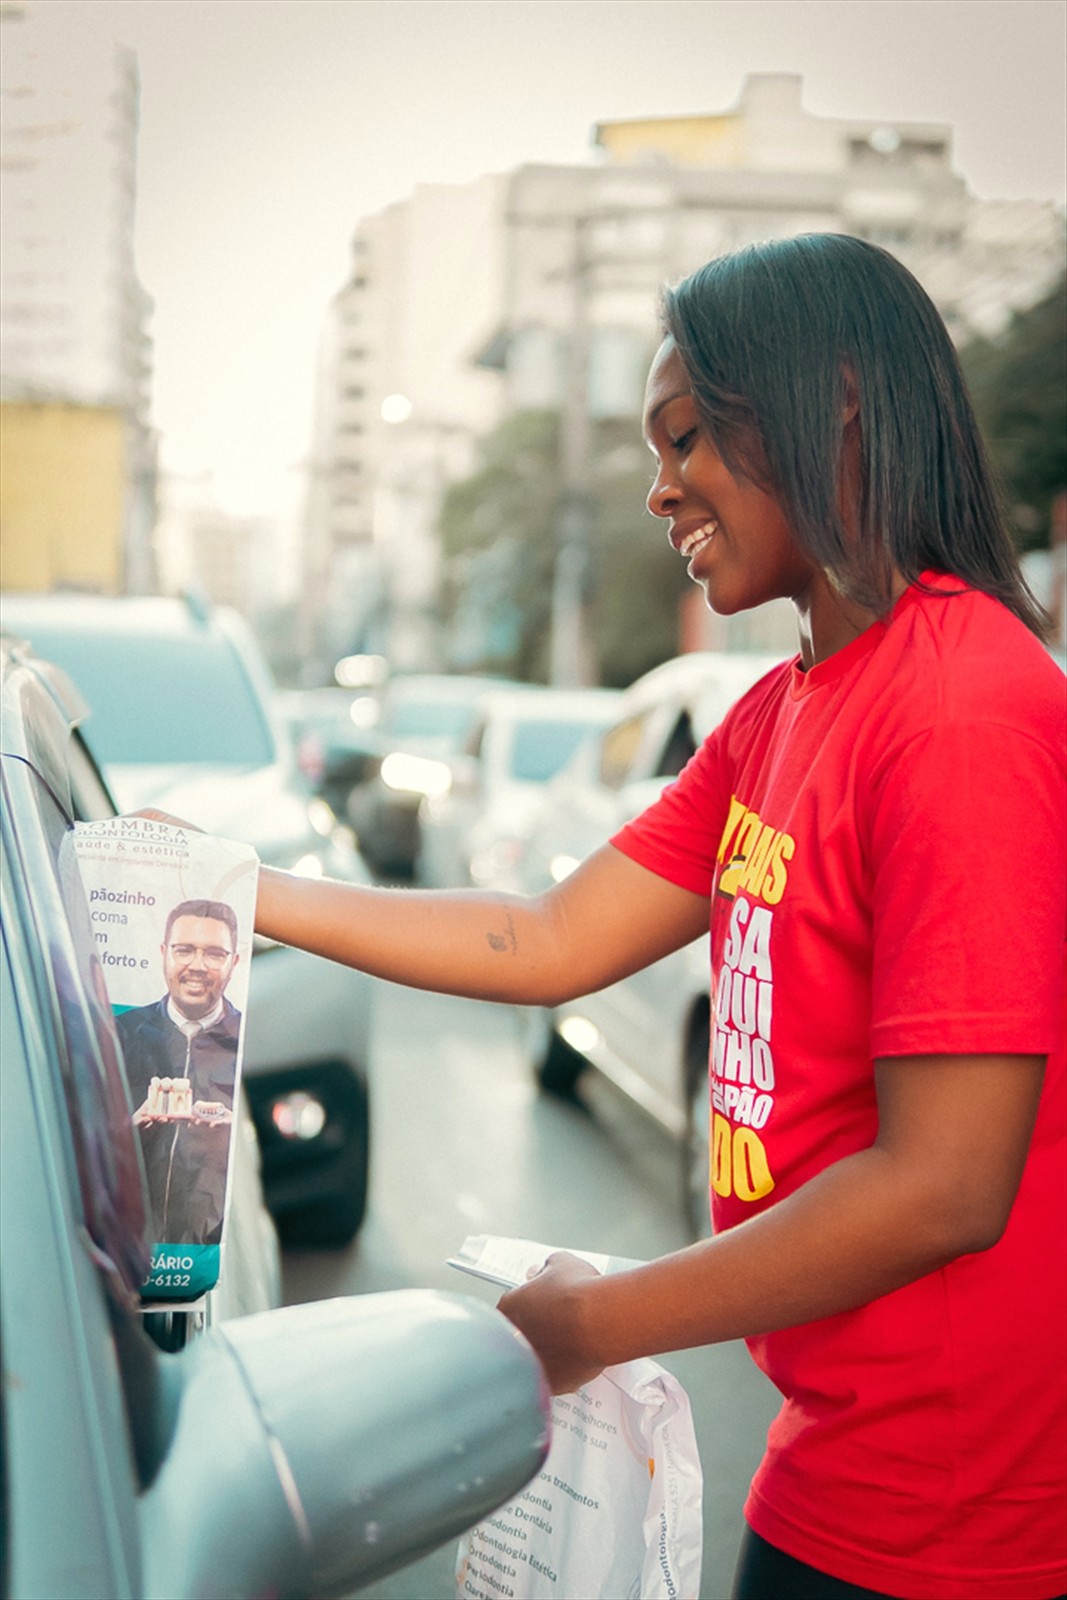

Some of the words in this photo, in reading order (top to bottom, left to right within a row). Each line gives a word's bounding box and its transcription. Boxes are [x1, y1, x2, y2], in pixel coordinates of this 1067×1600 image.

[78, 829, 189, 845] DONTOLOGIA
[79, 820, 186, 837] OIMBRA
[116, 842, 126, 852] &
[133, 845, 189, 858] estética
[90, 888, 156, 906] pãozinho
[91, 911, 128, 924] coma
[723, 896, 774, 981] SA
[102, 951, 136, 967] forto
[140, 959, 149, 969] e
[724, 1085, 774, 1129] PÃO
[472, 1528, 527, 1562] Odontologia
[659, 1512, 678, 1599] odontologia
